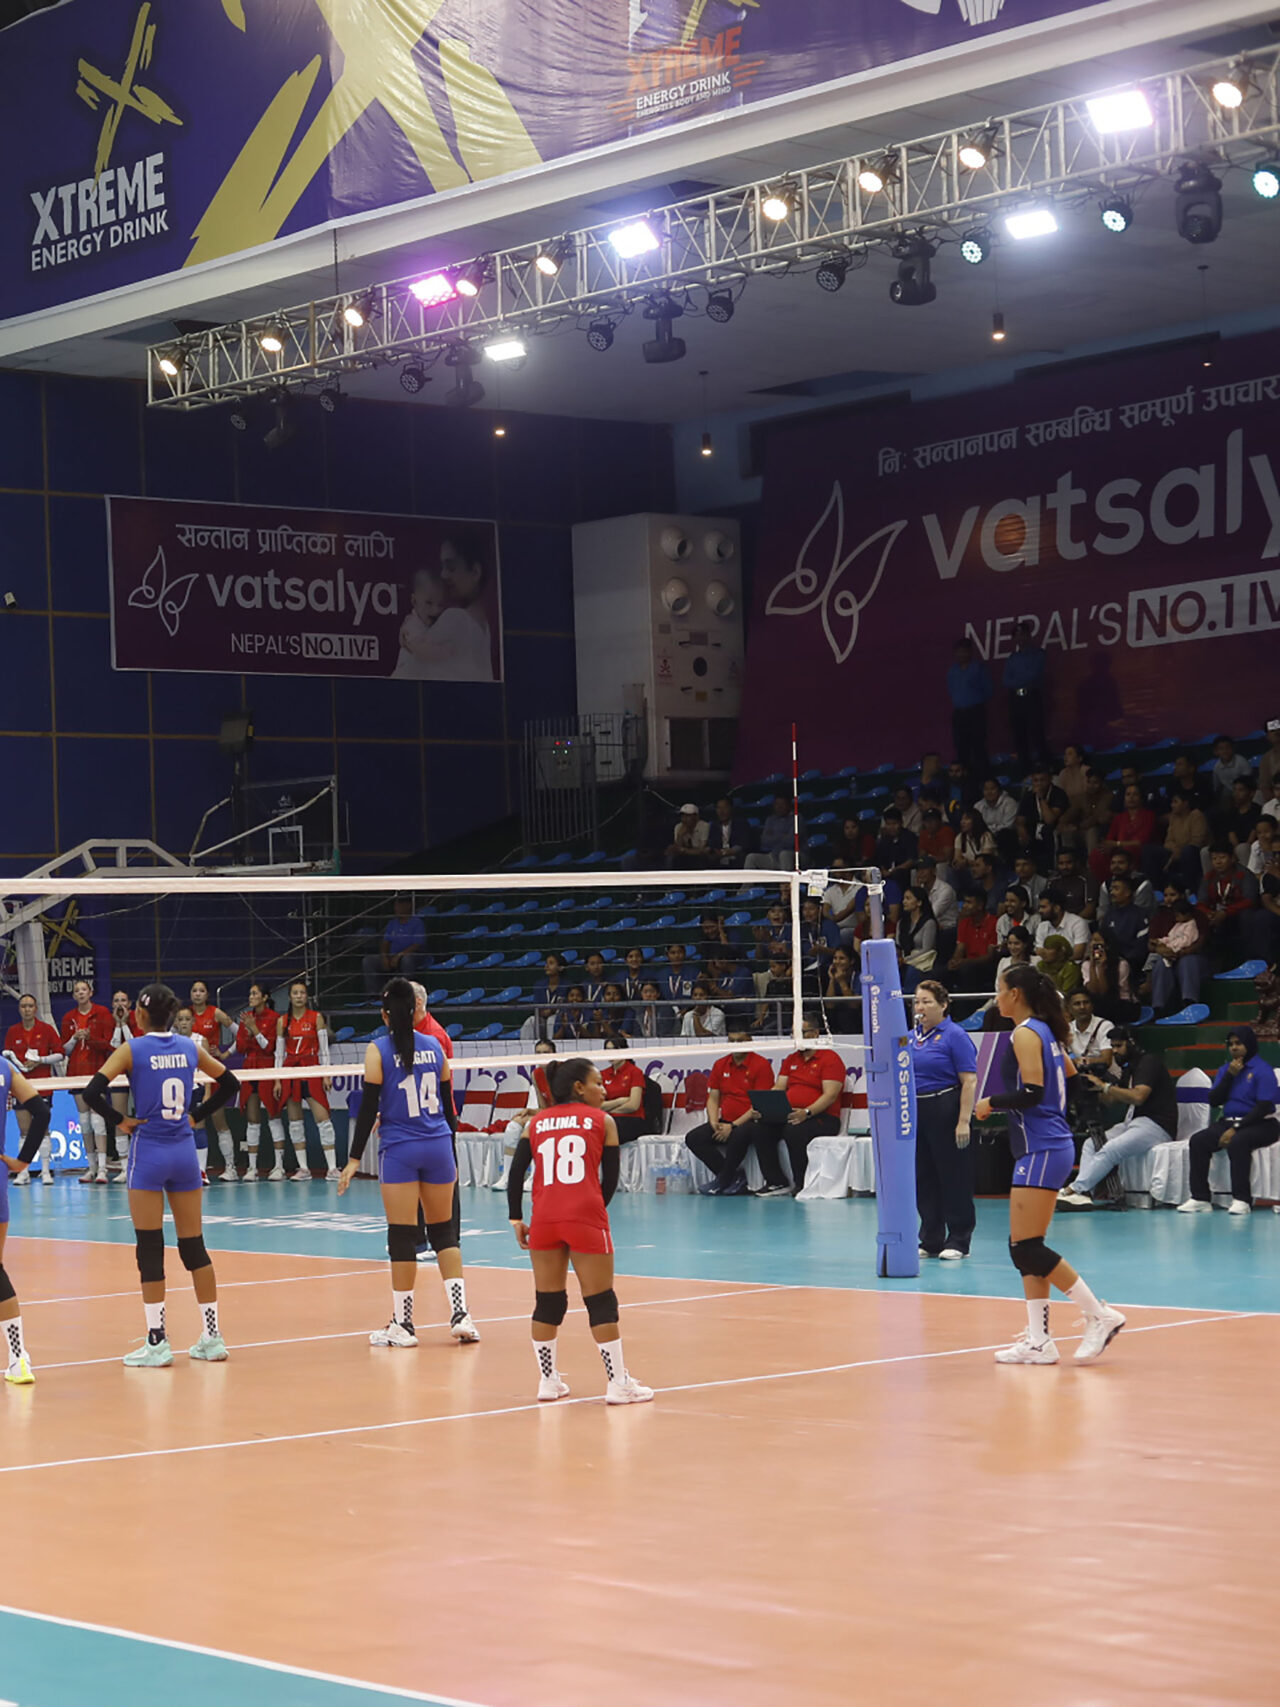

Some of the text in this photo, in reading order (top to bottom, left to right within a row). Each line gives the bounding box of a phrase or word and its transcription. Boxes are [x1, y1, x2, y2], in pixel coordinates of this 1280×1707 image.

[626, 26, 742, 96] XTREME
[636, 71, 730, 109] ENERGY DRINK
[30, 152, 165, 245] XTREME
[32, 209, 169, 271] ENERGY DRINK
[176, 524, 395, 559] सन्तान प्राप्तिका लागि
[206, 568, 398, 626] vatsalya
[964, 603, 1122, 661] NEPAL'S
[1135, 583, 1234, 642] NO.1
[231, 633, 376, 658] NEPAL'S NO.1 IVF
[46, 957, 94, 977] REME
[150, 1053, 188, 1070] SUNITA
[292, 1036, 303, 1054] 7
[393, 1050, 436, 1068] PGATI
[161, 1077, 185, 1120] 9
[398, 1072, 439, 1118] 14
[898, 1069, 912, 1136] Senoh
[536, 1115, 593, 1134] SALINA. S
[537, 1134, 586, 1186] 18
